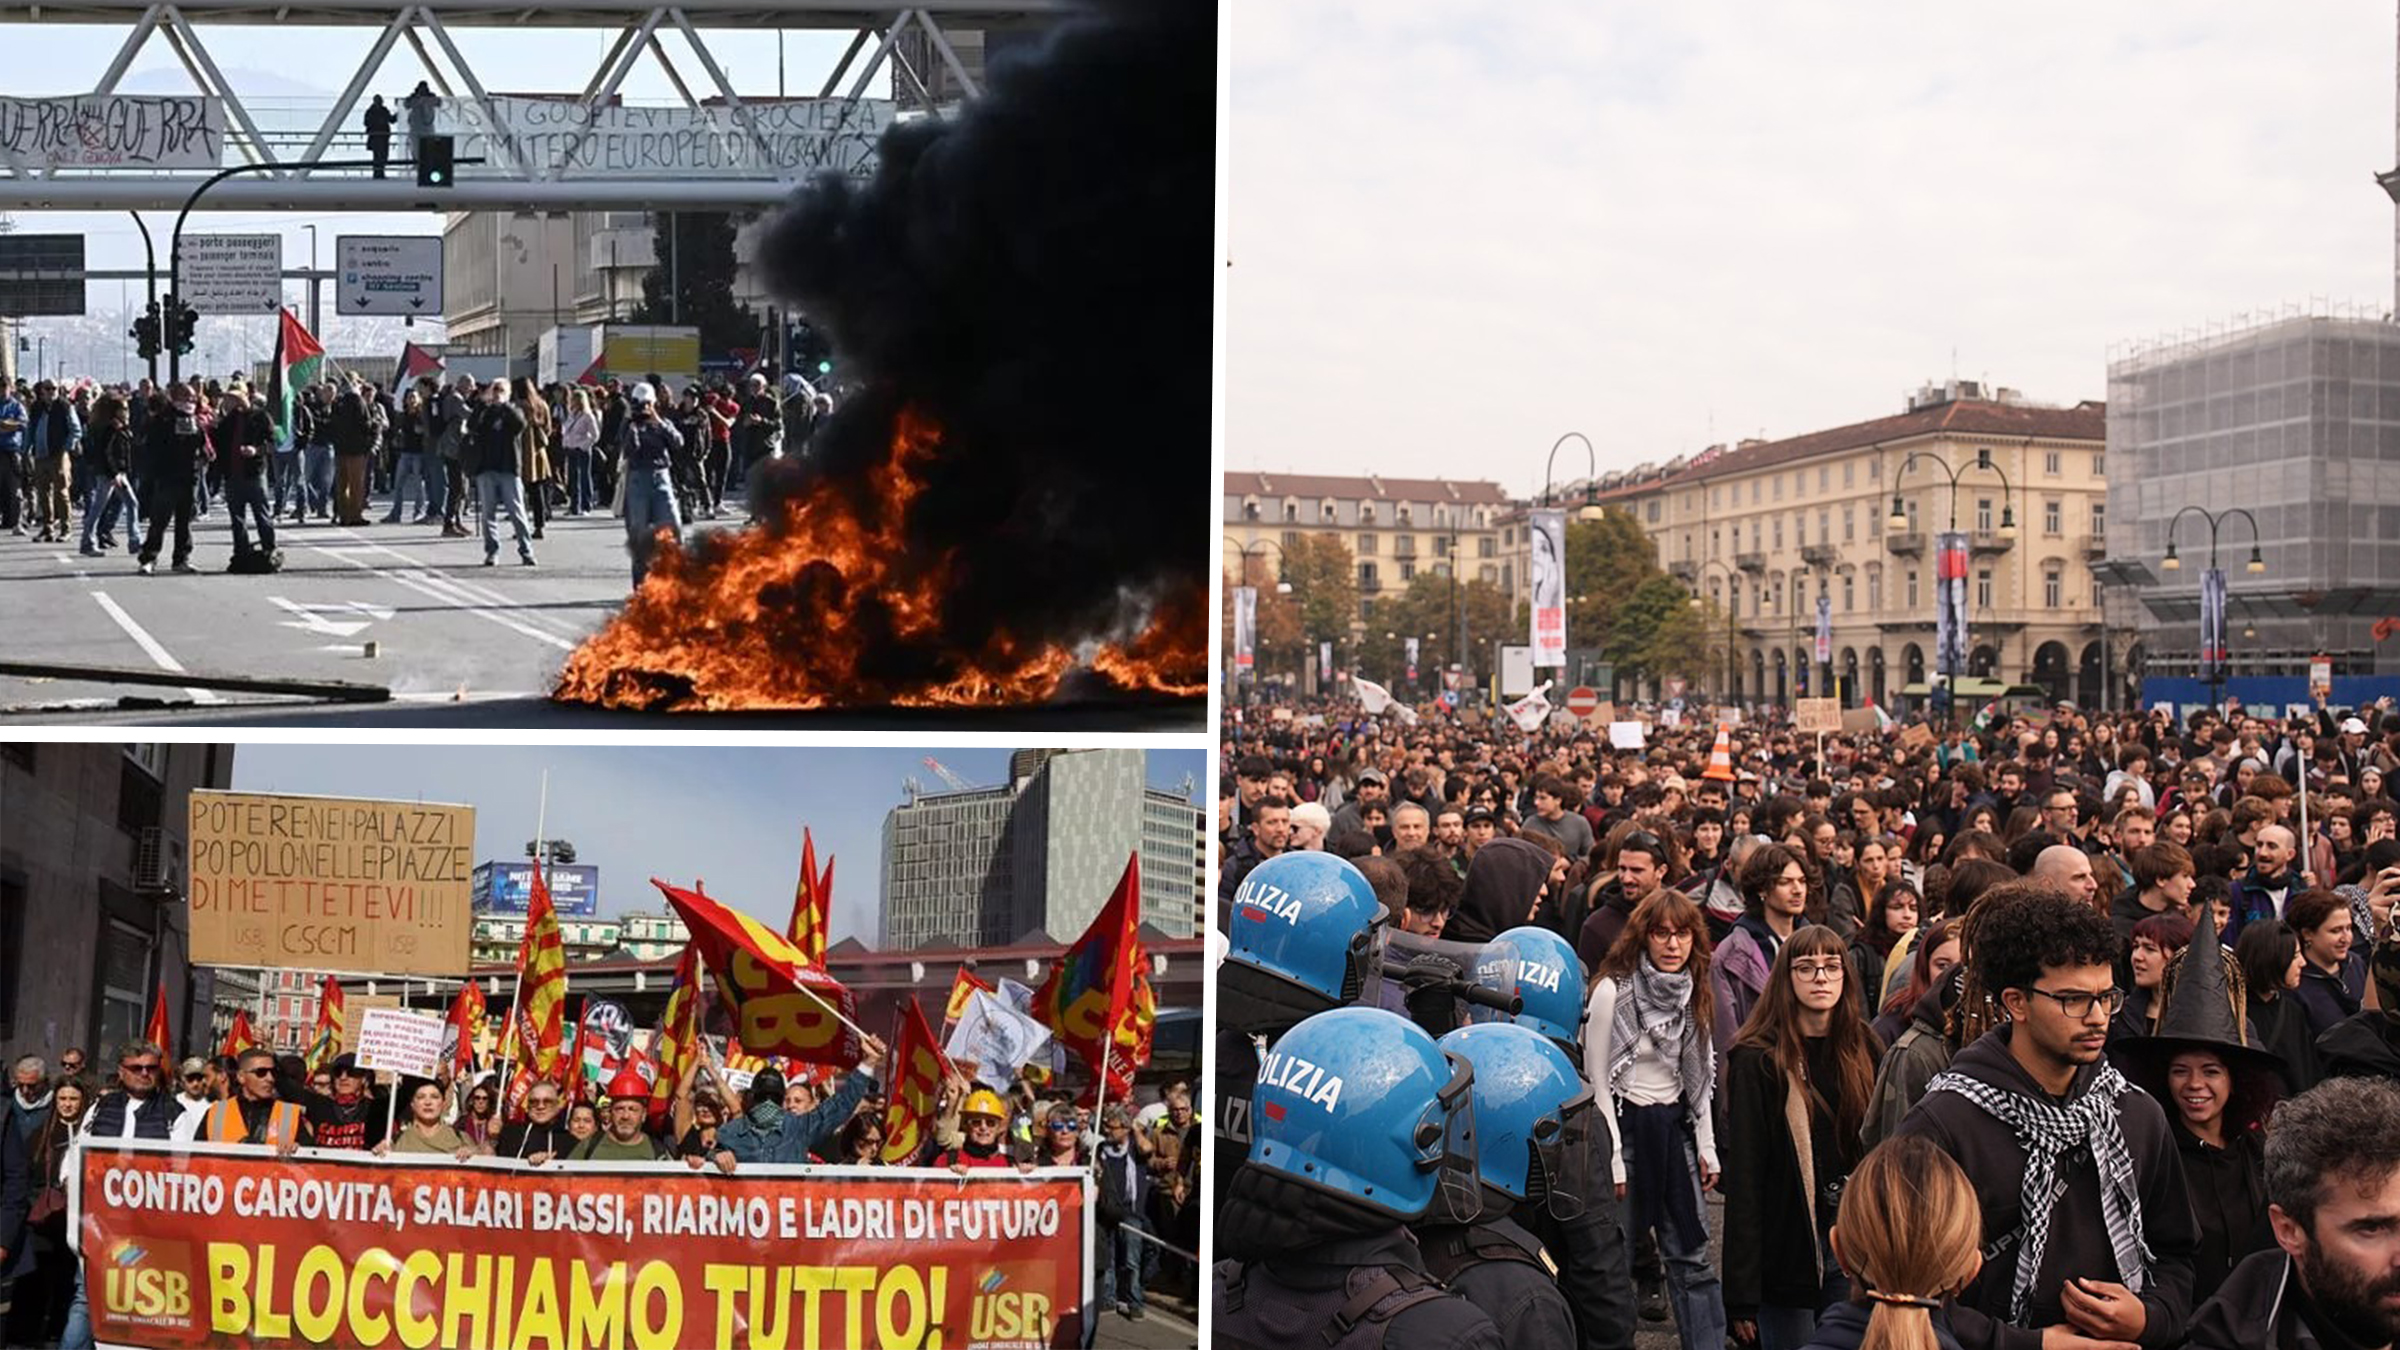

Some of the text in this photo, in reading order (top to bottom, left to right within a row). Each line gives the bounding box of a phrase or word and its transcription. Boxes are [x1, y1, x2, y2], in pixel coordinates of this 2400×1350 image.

[0, 97, 83, 154] UERRA
[105, 98, 216, 163] GUERRA
[606, 132, 722, 169] EUROPEO
[192, 799, 304, 839] POTERE
[354, 808, 454, 845] PALAZZI
[192, 838, 470, 882] POPOLO NELLE PIAZZE
[1235, 880, 1303, 927] OLIZIA
[1257, 1052, 1344, 1114] OLIZIA
[103, 1168, 1061, 1243] CONTRO CAROVITA, SALARI BASSI, RIARMO E LADRI DI FUTURO
[105, 1267, 192, 1317] USB
[206, 1240, 949, 1350] BLOCCHIAMO TUTTO!
[970, 1291, 1052, 1340] USB
